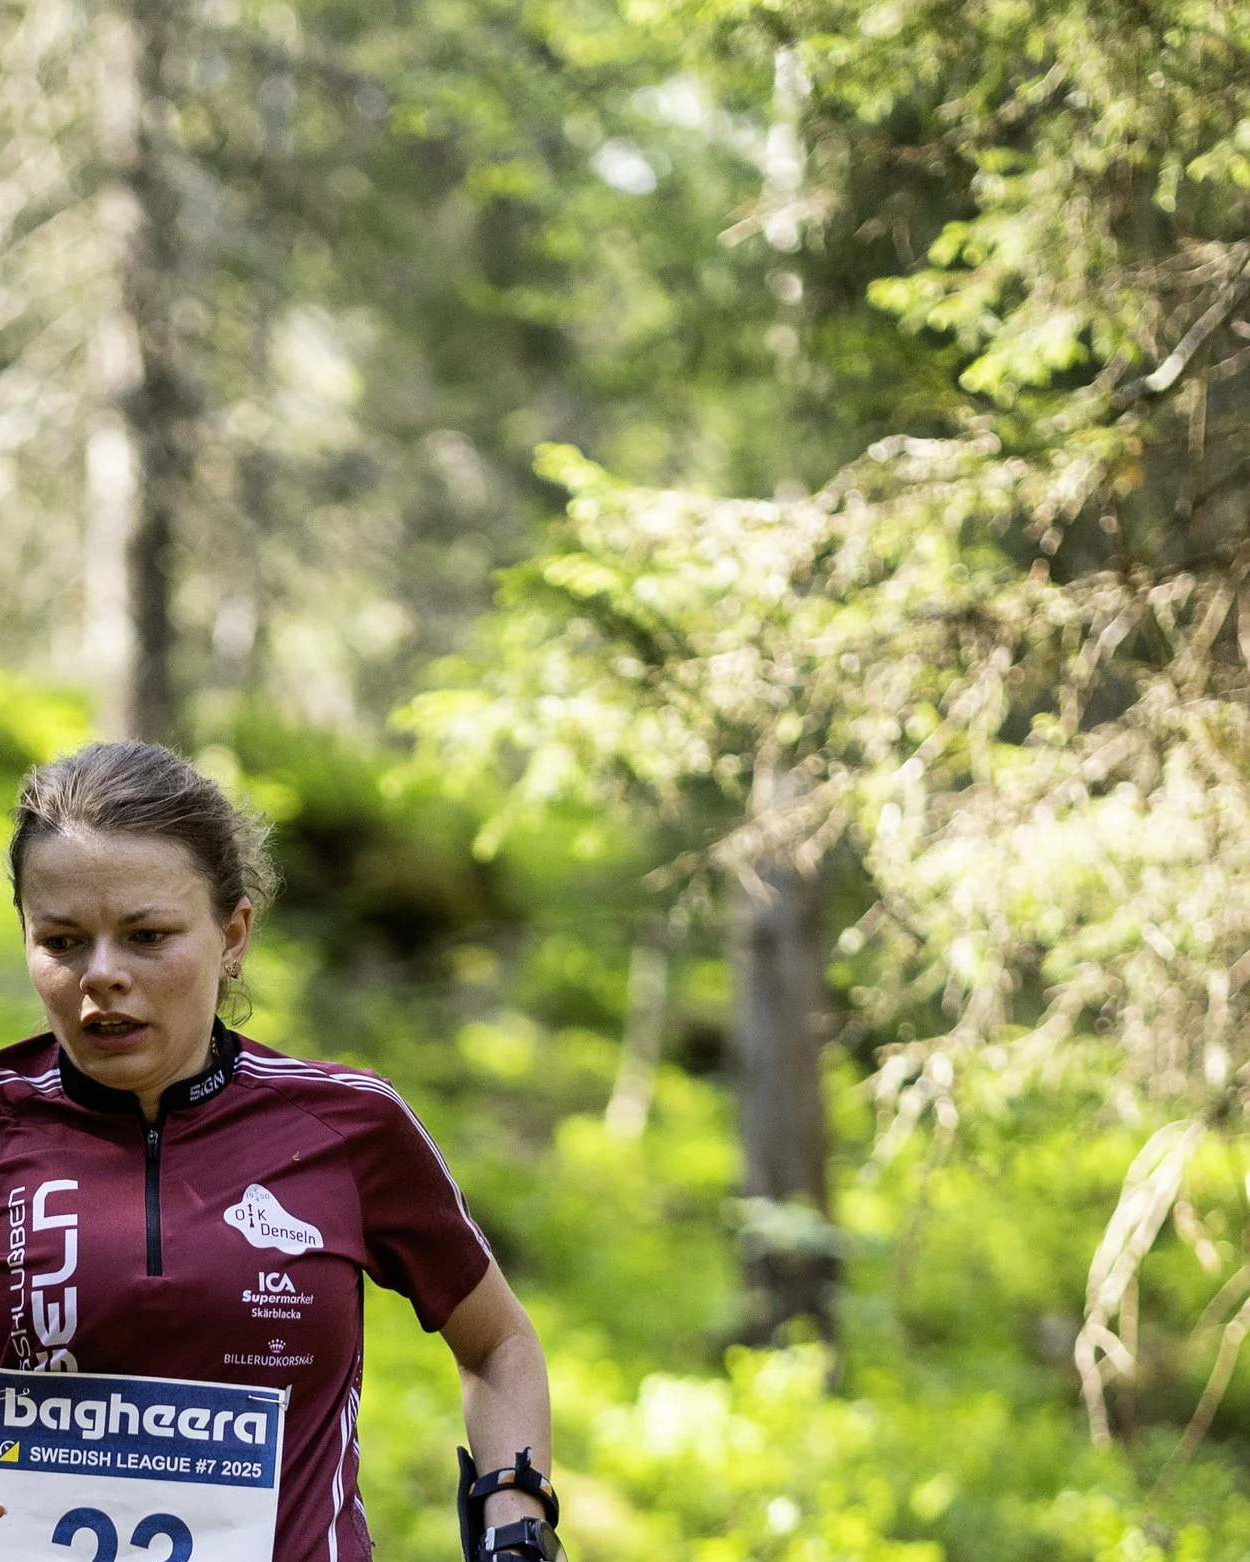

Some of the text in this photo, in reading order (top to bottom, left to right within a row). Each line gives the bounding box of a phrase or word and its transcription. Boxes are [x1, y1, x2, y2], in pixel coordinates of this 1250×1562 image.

[261, 1223, 316, 1246] Denseln
[258, 1271, 296, 1293] ICA
[242, 1289, 314, 1305] Supermarket
[251, 1307, 301, 1319] Skärblacka
[224, 1352, 314, 1367] BILLERUDKORSNÄS
[4, 1387, 268, 1444] bagheera
[30, 1447, 263, 1478] SWEDISH LEAGUE #7 2025
